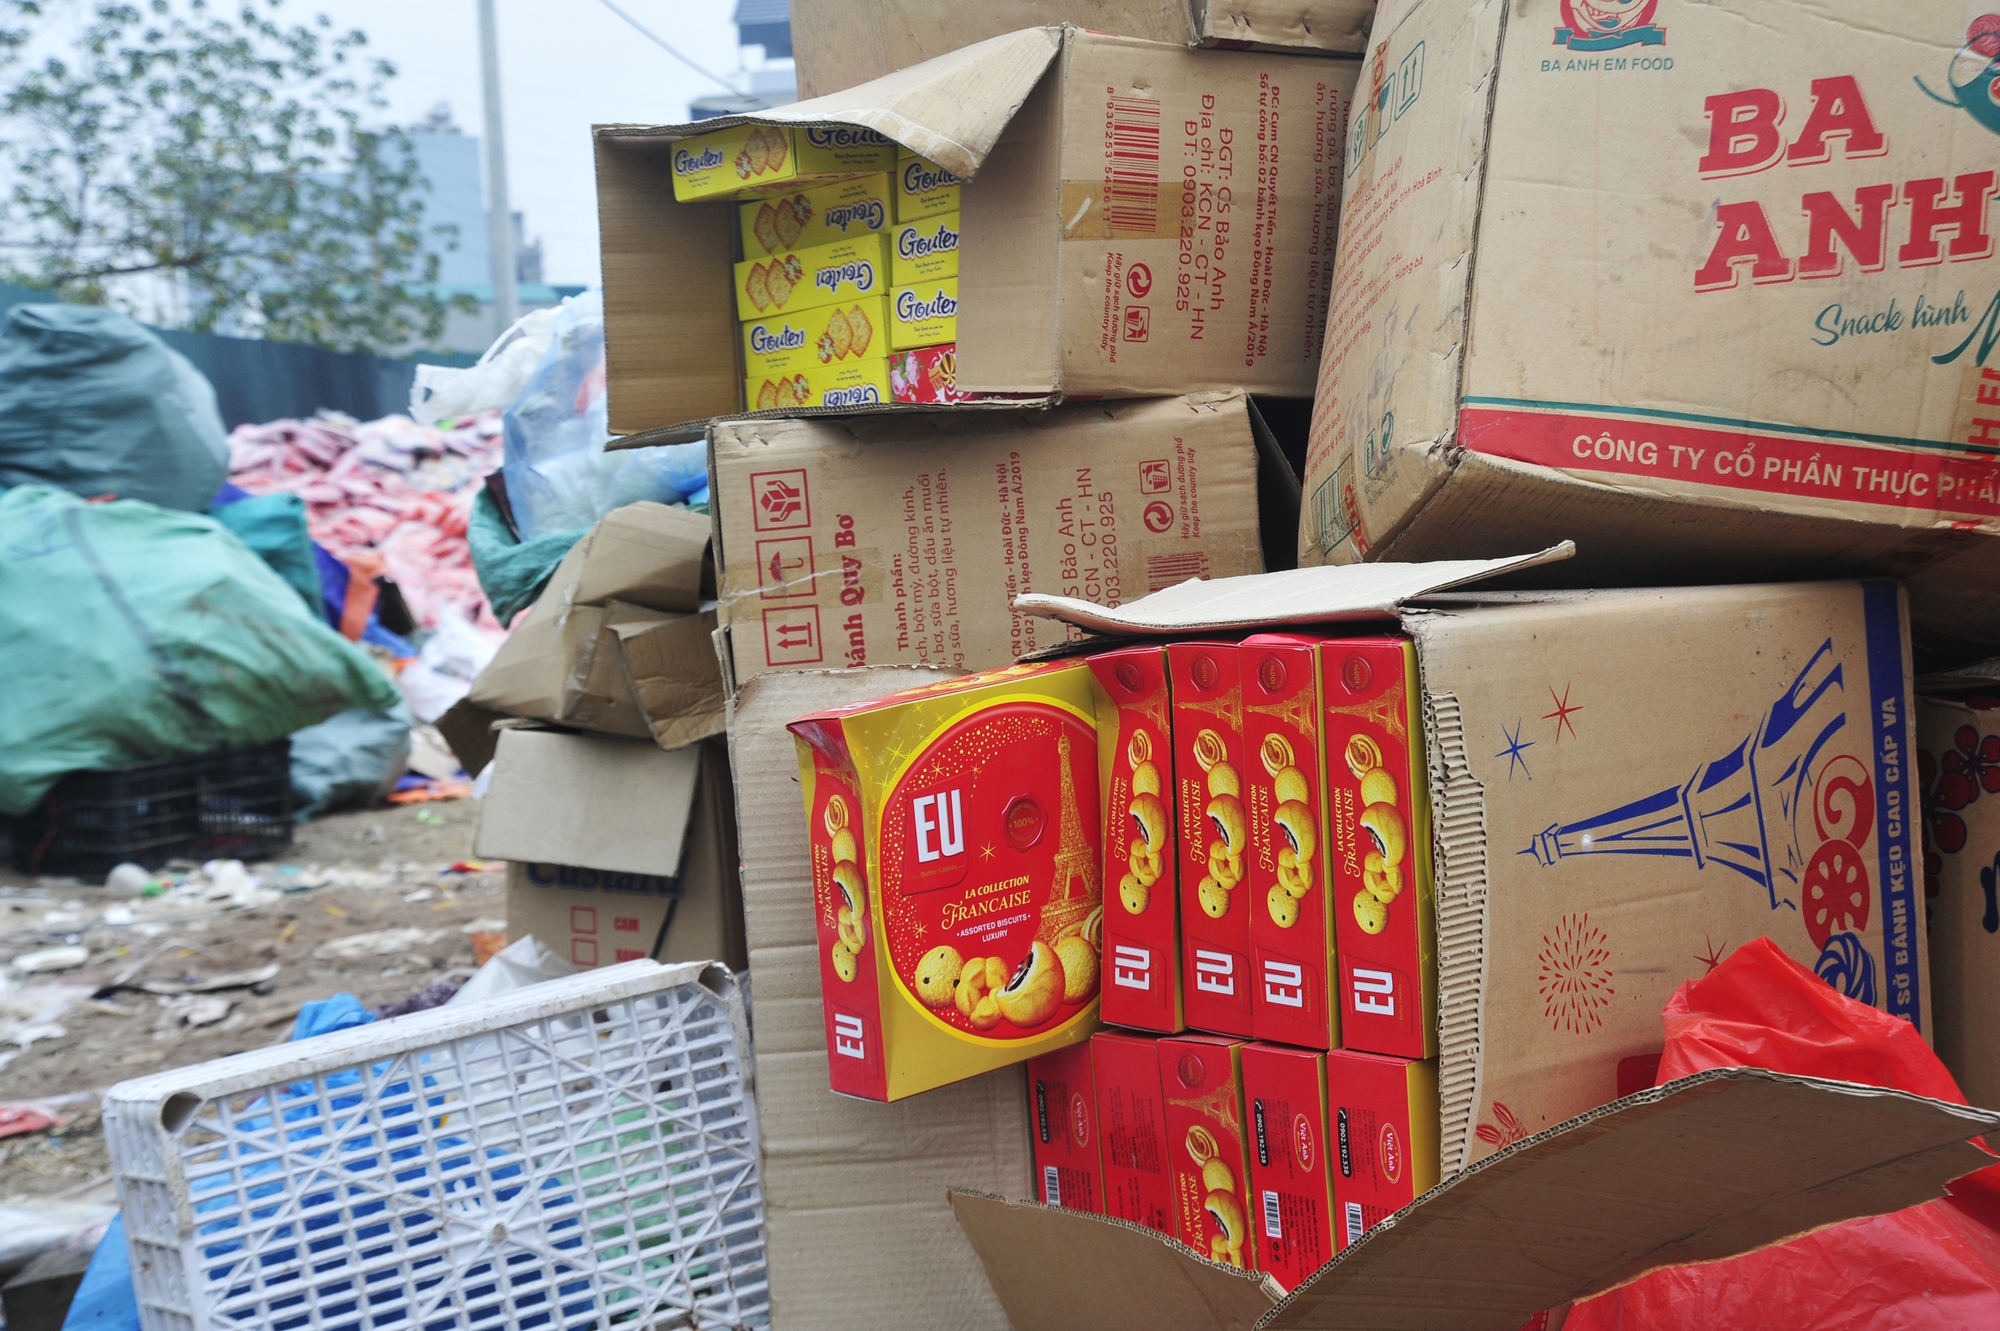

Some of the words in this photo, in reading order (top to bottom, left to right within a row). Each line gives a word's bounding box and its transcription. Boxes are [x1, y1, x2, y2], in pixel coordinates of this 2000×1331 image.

[1259, 72, 1270, 89] Số
[1540, 58, 1562, 73] BA
[1565, 58, 1599, 72] ANH
[1603, 58, 1627, 71] EM
[1631, 57, 1675, 71] FOOD
[1106, 86, 1114, 95] 8
[1256, 92, 1267, 107] tự
[1270, 85, 1280, 109] ĐC:
[1198, 93, 1215, 129] Địa
[1256, 109, 1268, 141] công
[1267, 111, 1279, 141] Cụm
[1104, 101, 1114, 159] 936253
[1184, 120, 1198, 157] ĐT:
[1313, 110, 1326, 163] hương
[1697, 74, 1889, 181] BA
[674, 147, 723, 175] Gouten
[1199, 137, 1214, 174] chỉ:
[1218, 127, 1234, 180] ĐGT:
[1257, 144, 1268, 165] bố:
[1268, 144, 1278, 164] CN
[1258, 167, 1267, 185] 02
[1265, 166, 1279, 205] Quyết
[1313, 167, 1324, 198] sữa,
[1102, 166, 1113, 223] 545611
[1198, 182, 1213, 231] KCN
[1217, 186, 1232, 214] CS
[1255, 187, 1267, 221] bánh
[826, 200, 885, 232] Gouten
[1265, 208, 1277, 236] Tiến
[1307, 203, 1324, 256] hương
[1694, 170, 2000, 294] ANH
[1175, 165, 1197, 312] 0903.220.925
[1214, 221, 1230, 260] Bảo
[1252, 223, 1264, 248] kẹo
[1193, 253, 1209, 286] CT
[1249, 250, 1263, 286] Đông
[1263, 246, 1274, 276] Hoài
[1307, 260, 1322, 289] liệu
[816, 262, 873, 293] Gouten
[1210, 266, 1227, 311] Anh
[1261, 278, 1273, 304] Đức
[1101, 295, 1111, 331] country
[1248, 288, 1260, 318] Nam
[1810, 297, 1905, 347] Snack
[1911, 289, 1972, 330] hình
[751, 324, 805, 352] Gouten
[1190, 307, 1205, 341] HN
[1259, 314, 1270, 332] Hà
[1099, 333, 1110, 351] tidy
[1244, 321, 1259, 368] Á/2019
[1256, 334, 1268, 357] Nội
[1187, 447, 1196, 464] tidy
[1572, 431, 1658, 466] CÔNG
[1668, 444, 1705, 471] TY
[1713, 442, 1756, 479] CỔ
[1763, 452, 1843, 489] PHẦN
[1851, 465, 1930, 500] THỰC
[996, 462, 1008, 484] Nội
[1009, 451, 1024, 495] Á/2019
[1075, 468, 1093, 498] HN
[1187, 467, 1199, 499] country
[901, 485, 917, 522] kính,
[917, 473, 933, 512] muối
[935, 467, 950, 515] nhiên.
[998, 486, 1009, 503] Hà
[1189, 500, 1199, 514] the
[921, 516, 934, 534] ăn
[940, 517, 952, 534] tự
[1000, 511, 1012, 536] Đức
[1013, 496, 1027, 525] Nam
[1055, 497, 1075, 538] Anh
[834, 513, 856, 549] Bơ
[1080, 518, 1098, 547] CT
[1191, 516, 1201, 538] Keep
[904, 526, 921, 575] đường
[923, 537, 937, 566] dầu
[941, 537, 956, 564] liệu
[1003, 537, 1015, 566] Hoài
[1017, 527, 1031, 560] Đông
[890, 552, 907, 599] phần:
[1020, 562, 1033, 584] kẹo
[1060, 543, 1078, 580] Bảo
[839, 554, 866, 607] Quy
[909, 577, 924, 604] mỳ,
[926, 569, 940, 598] bột,
[943, 567, 958, 617] hương
[1005, 574, 1018, 600] Tiến
[893, 601, 909, 652] Thành
[912, 607, 926, 633] bột
[928, 602, 941, 627] sữa
[1024, 619, 1035, 635] 02
[932, 631, 946, 654] bơ,
[948, 619, 961, 649] sữa,
[1011, 640, 1022, 657] CN
[1880, 697, 1896, 728] VA
[1879, 734, 1901, 785] CẤP
[1110, 776, 1121, 821] COLLECTION
[1181, 778, 1191, 825] COLLECTION
[1250, 783, 1260, 831] COLLECTION
[1334, 787, 1344, 836] COLLECTION
[1885, 789, 1902, 838] CAO
[913, 788, 965, 864] EU
[1013, 816, 1035, 829] 100%
[1109, 821, 1118, 837] LA
[1113, 777, 1128, 862] FRANCAISE
[1184, 825, 1192, 840] LA
[1190, 779, 1207, 865] FRANCAISE
[1258, 784, 1275, 873] FRANCAISE
[1343, 788, 1361, 878] FRANCAISE
[1252, 832, 1260, 847] LA
[1336, 836, 1345, 852] LA
[814, 843, 823, 889] COLLECTION
[1887, 844, 1912, 893] KẸO
[820, 845, 838, 930] FRANCAISE
[965, 887, 977, 900] LA
[977, 874, 1030, 898] COLLECTION
[941, 889, 1032, 931] FRANCAISE
[960, 921, 996, 937] ASSORTED
[997, 913, 1027, 928] BISCUITS
[982, 928, 1009, 943] LUXURY
[1889, 898, 1909, 966] BÁNH
[1114, 944, 1150, 990] EU
[1196, 948, 1234, 995] EU
[1264, 959, 1303, 1008] EU
[1352, 967, 1395, 1016] EU
[1893, 973, 1911, 1005] SỞ
[833, 1012, 865, 1060] EU
[1255, 1113, 1268, 1164] 0902.192.538
[1298, 1121, 1309, 1141] Việt
[1384, 1131, 1395, 1151] Việt
[1301, 1142, 1309, 1161] Anh
[1338, 1122, 1350, 1175] 0902.192.538
[1387, 1152, 1396, 1172] Anh
[1178, 1171, 1192, 1217] COLLECTION
[1183, 1217, 1193, 1232] LA
